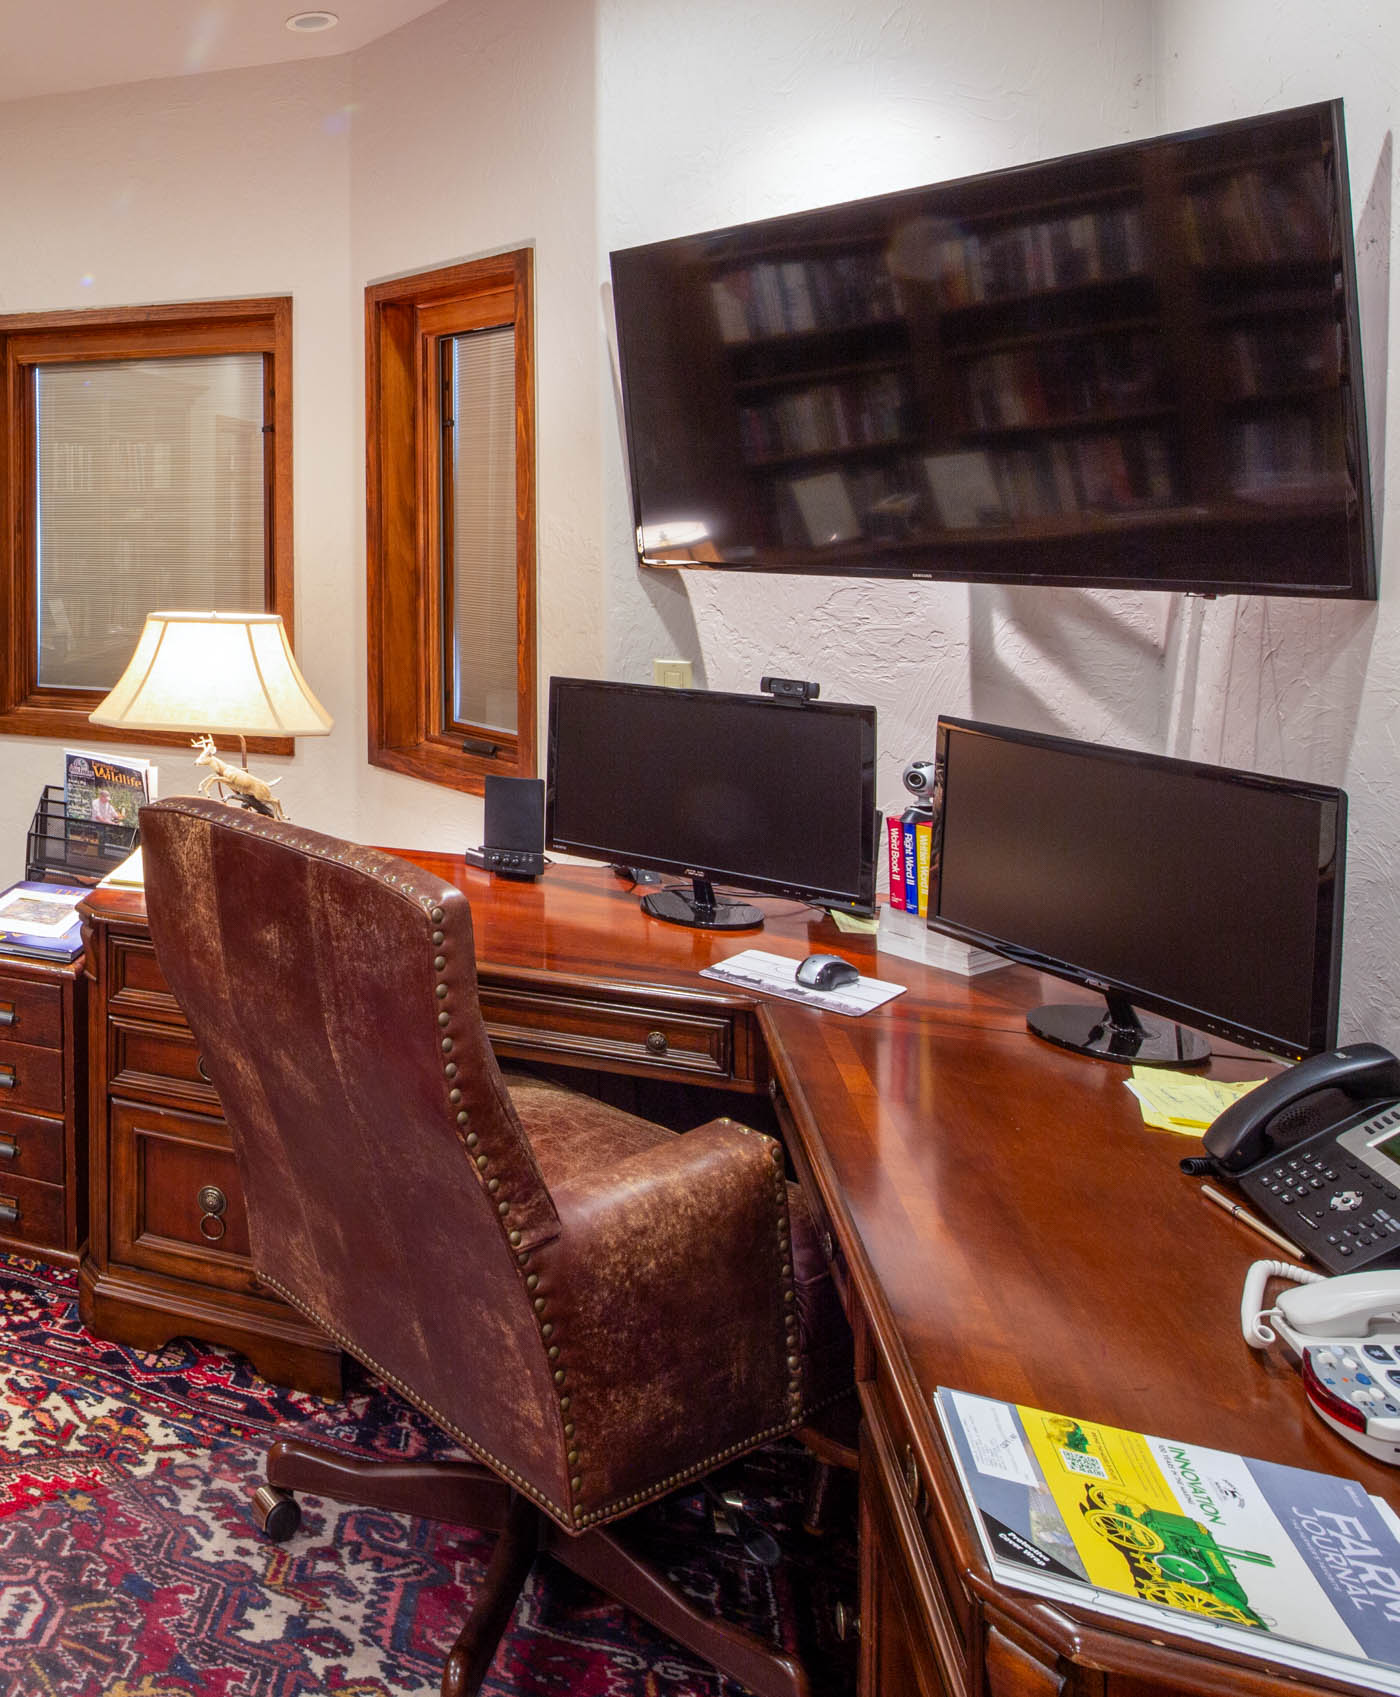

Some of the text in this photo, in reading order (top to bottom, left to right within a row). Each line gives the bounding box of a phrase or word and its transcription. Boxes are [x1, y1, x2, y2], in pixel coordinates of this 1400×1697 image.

[92, 765, 142, 788] Wildlife
[891, 828, 899, 850] Word
[904, 833, 913, 854] Right
[920, 835, 928, 865] Written
[891, 851, 899, 872] Book
[906, 856, 914, 879] Word
[920, 866, 928, 888] Word
[1168, 1446, 1226, 1526] INNOVATION
[998, 1533, 1046, 1566] Cover Wrap
[1008, 1532, 1050, 1561] Protective
[1292, 1506, 1376, 1610] JOURNAL
